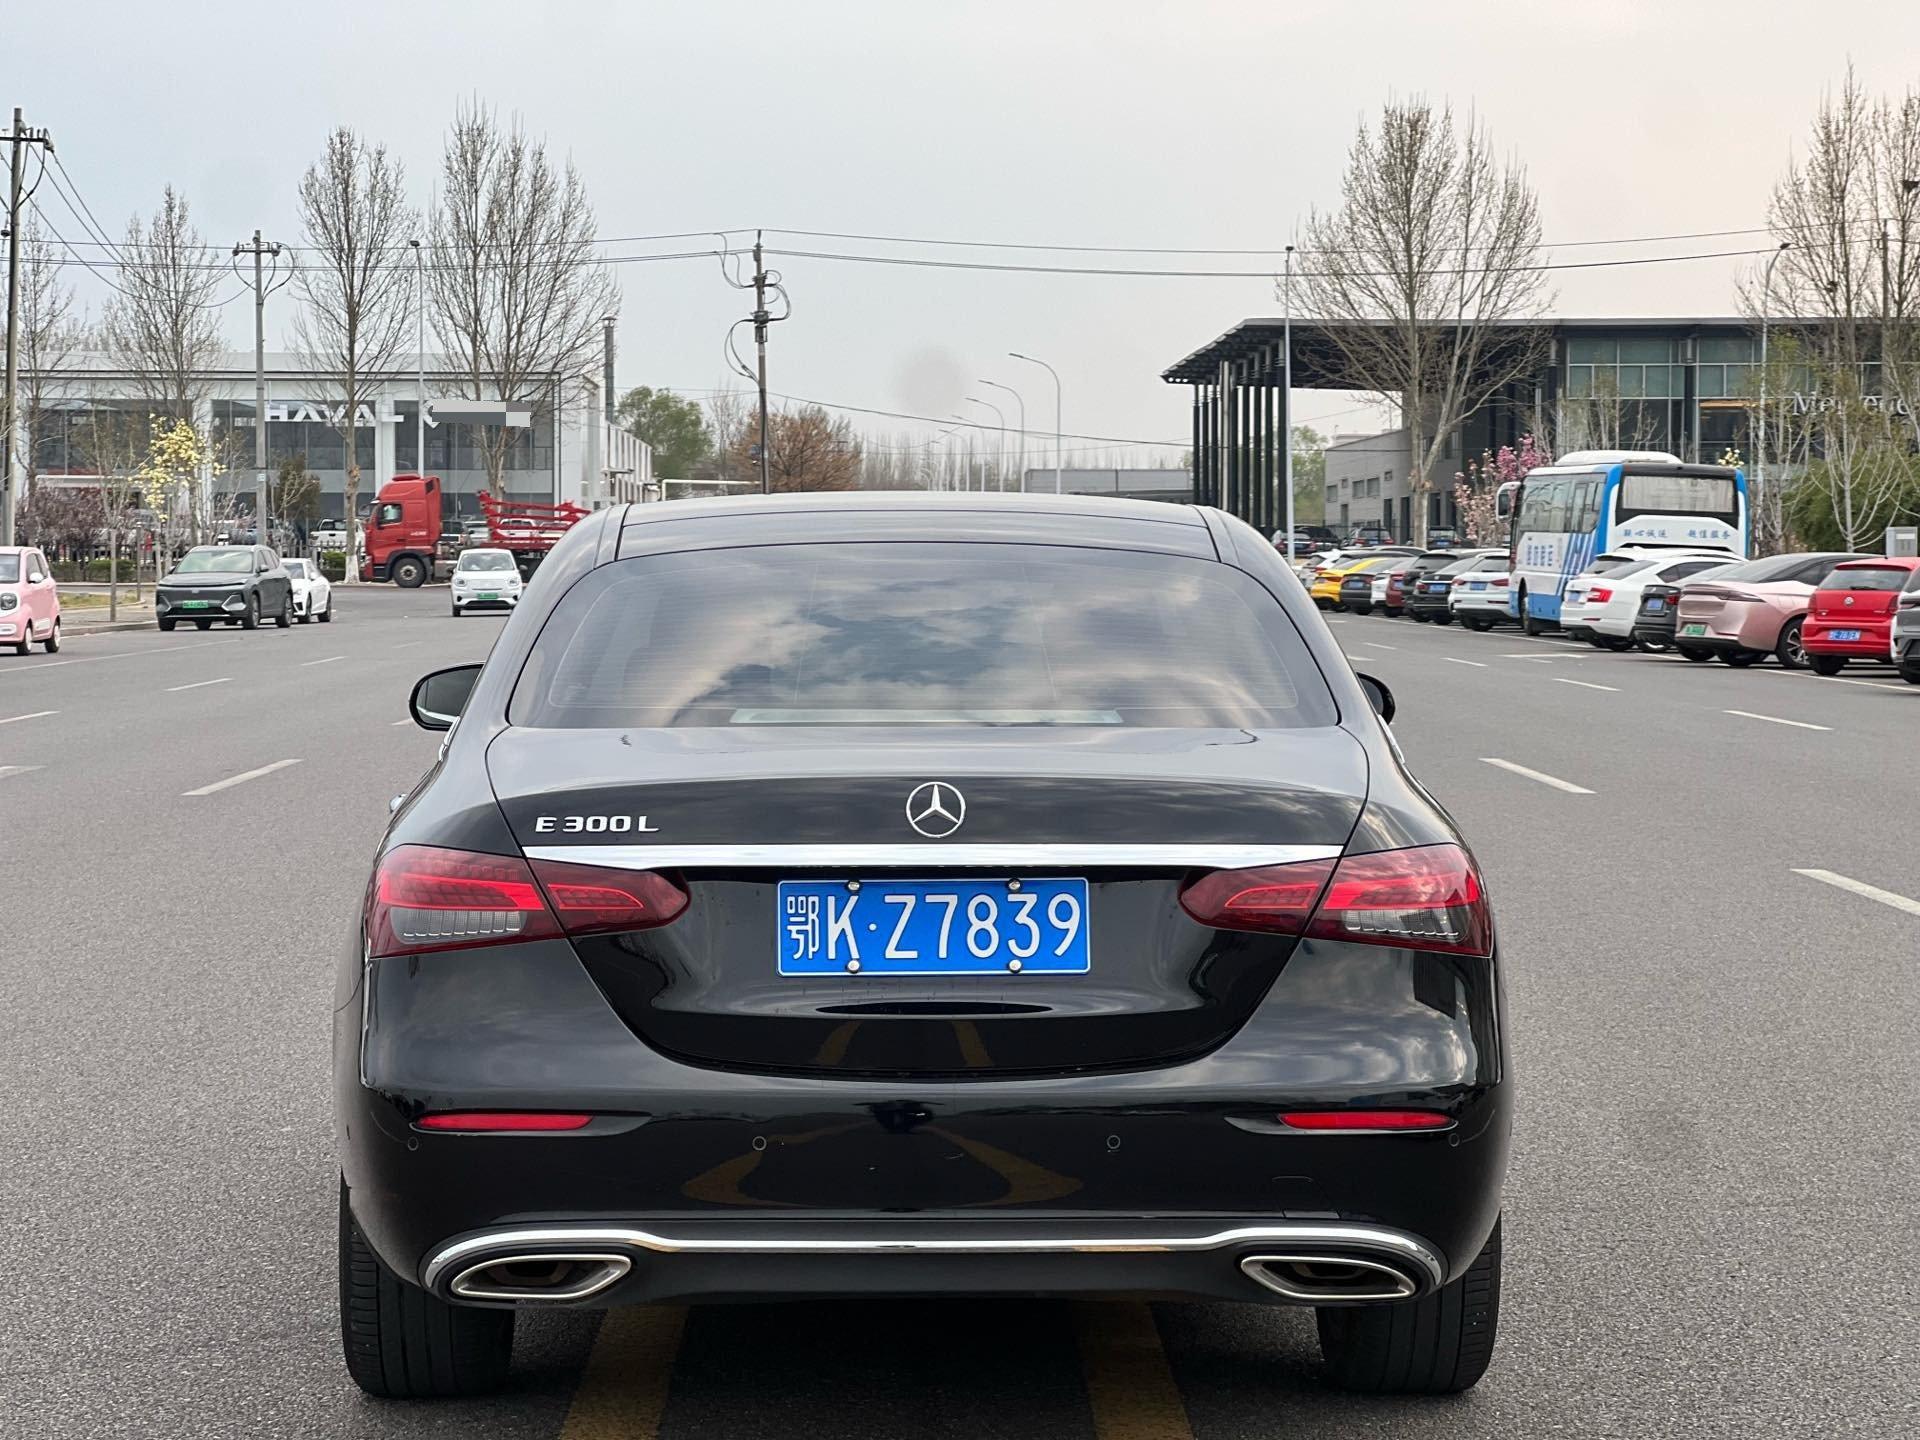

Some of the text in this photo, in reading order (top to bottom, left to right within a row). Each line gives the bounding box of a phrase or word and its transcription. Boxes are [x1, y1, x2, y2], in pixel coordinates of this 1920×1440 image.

[264, 402, 404, 423] HAVAL
[535, 815, 660, 832] E 300 L
